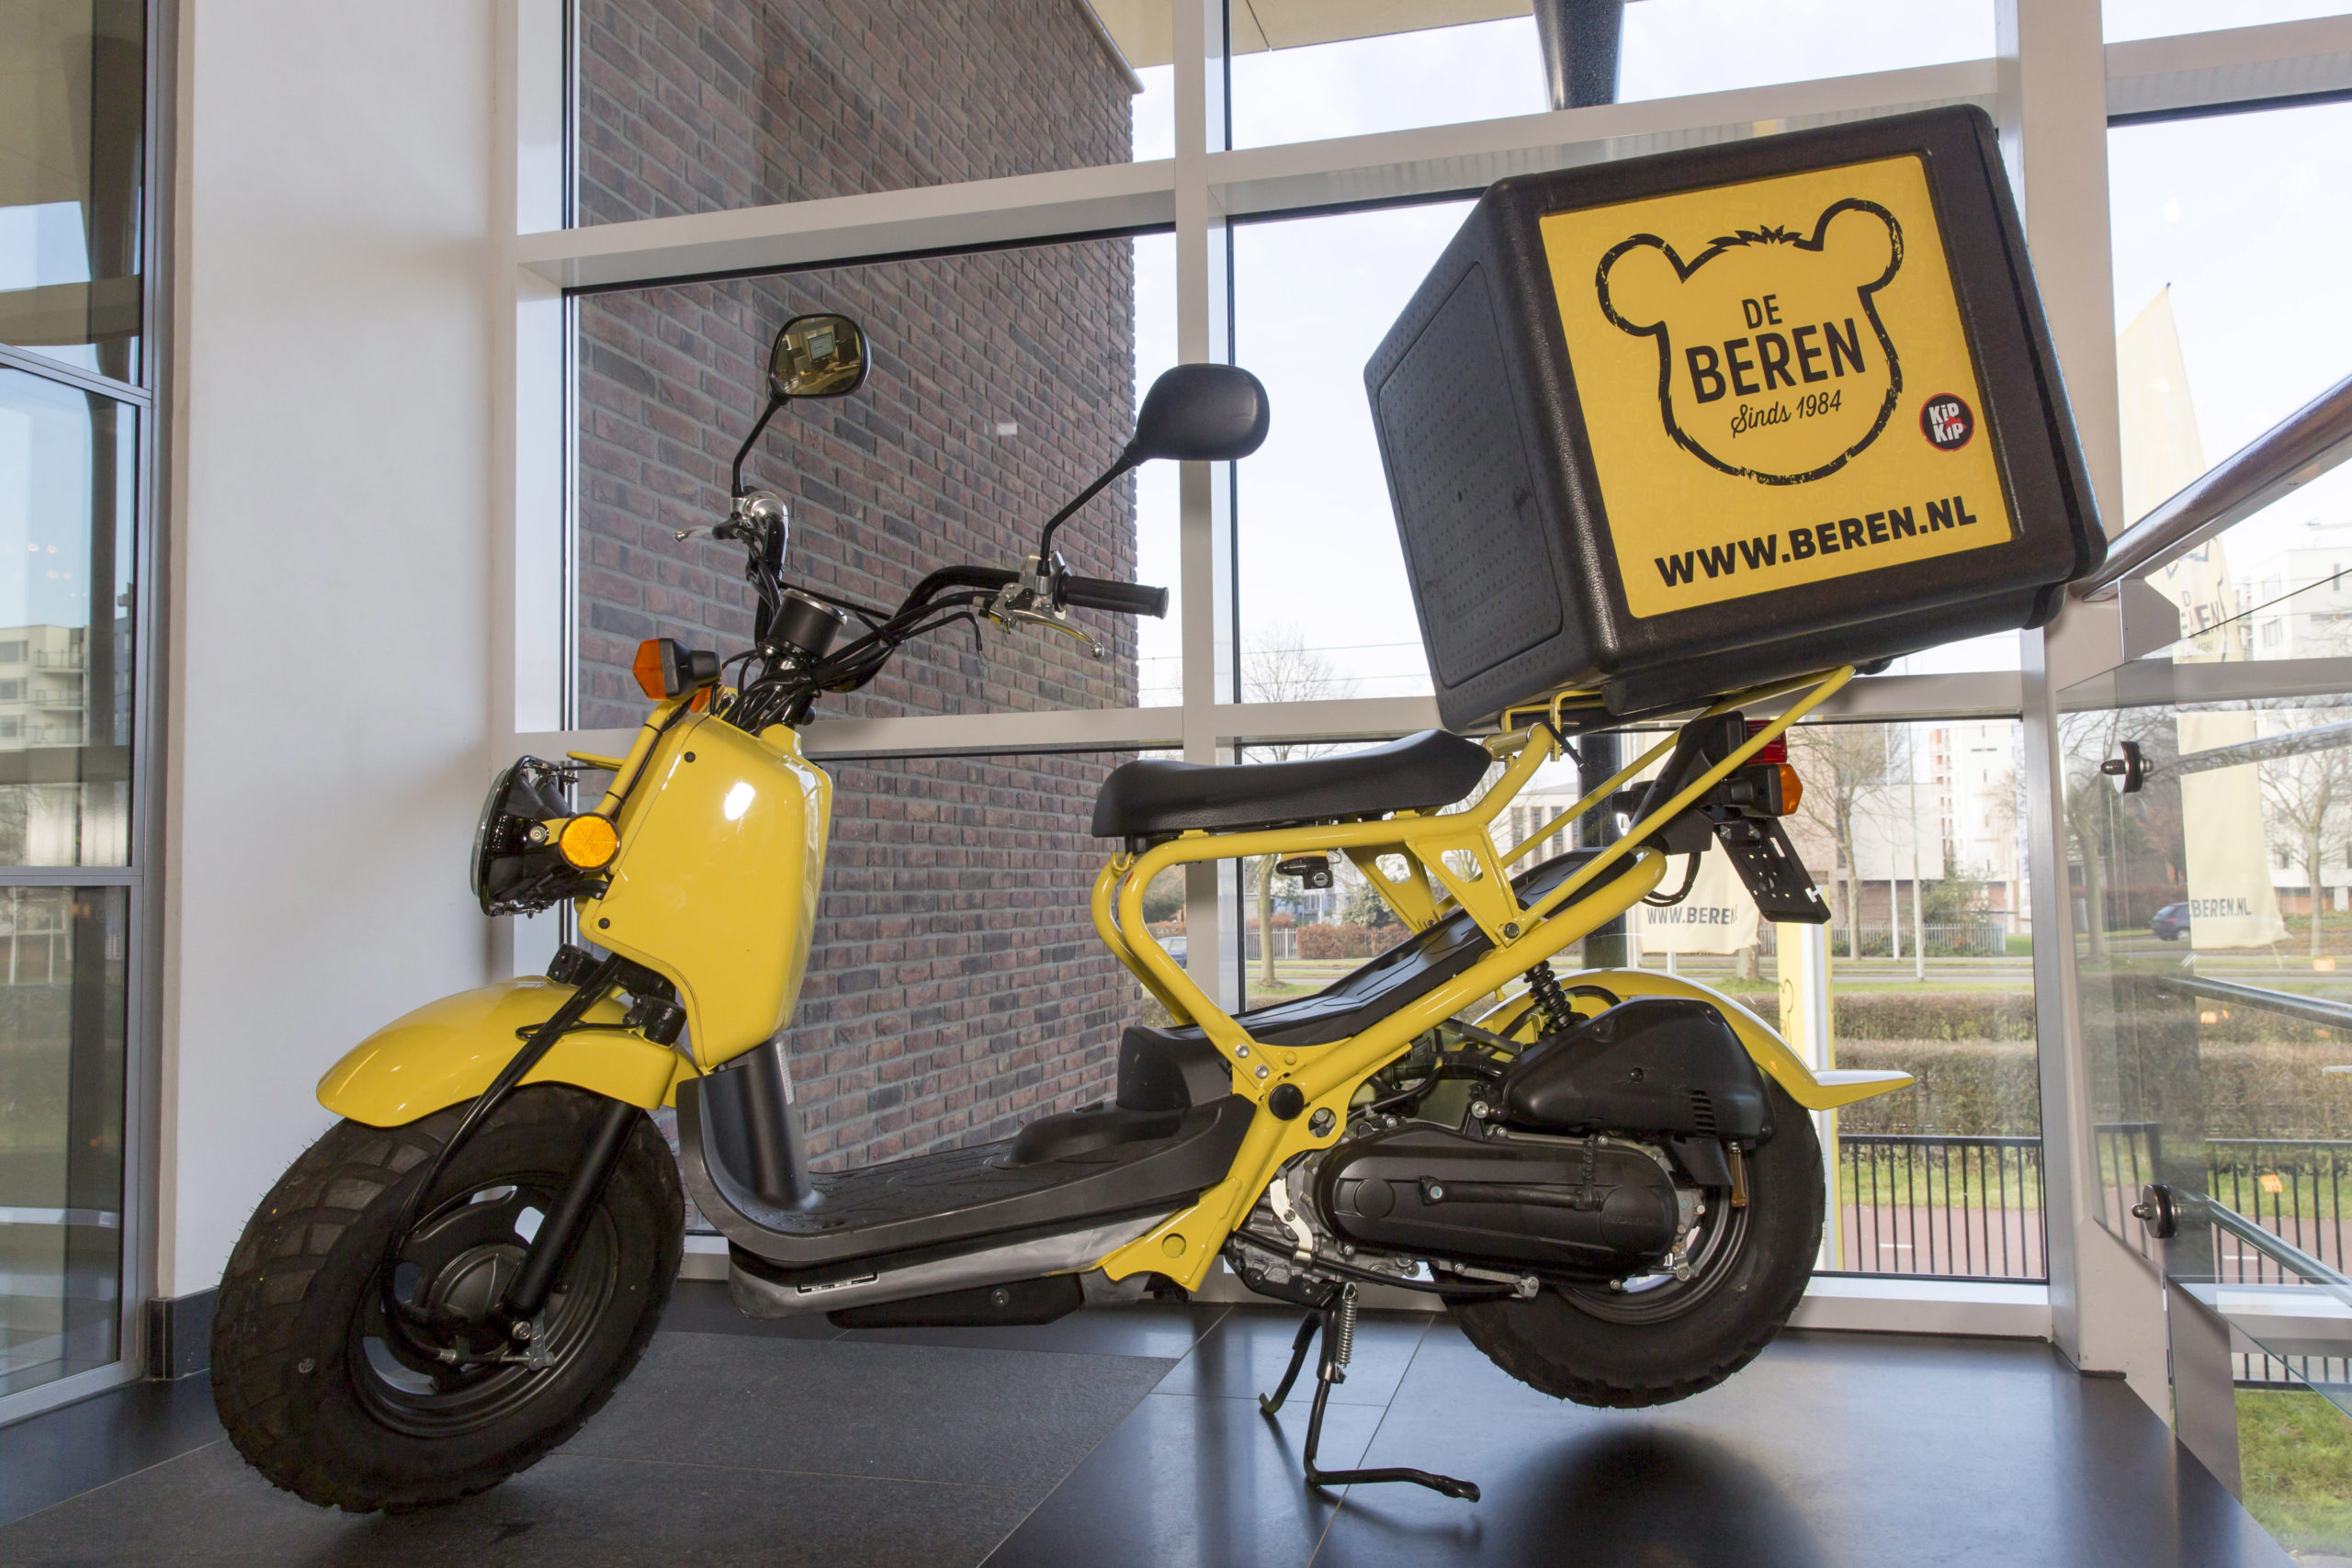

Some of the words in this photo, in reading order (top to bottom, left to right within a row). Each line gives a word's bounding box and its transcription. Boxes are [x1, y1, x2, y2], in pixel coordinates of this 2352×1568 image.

[1742, 294, 1782, 329] DE
[1685, 318, 1865, 403] BEREN
[1731, 400, 1792, 439] Sinds
[1796, 389, 1842, 419] 1984
[1654, 495, 1977, 587] WWW.BEREN.NL
